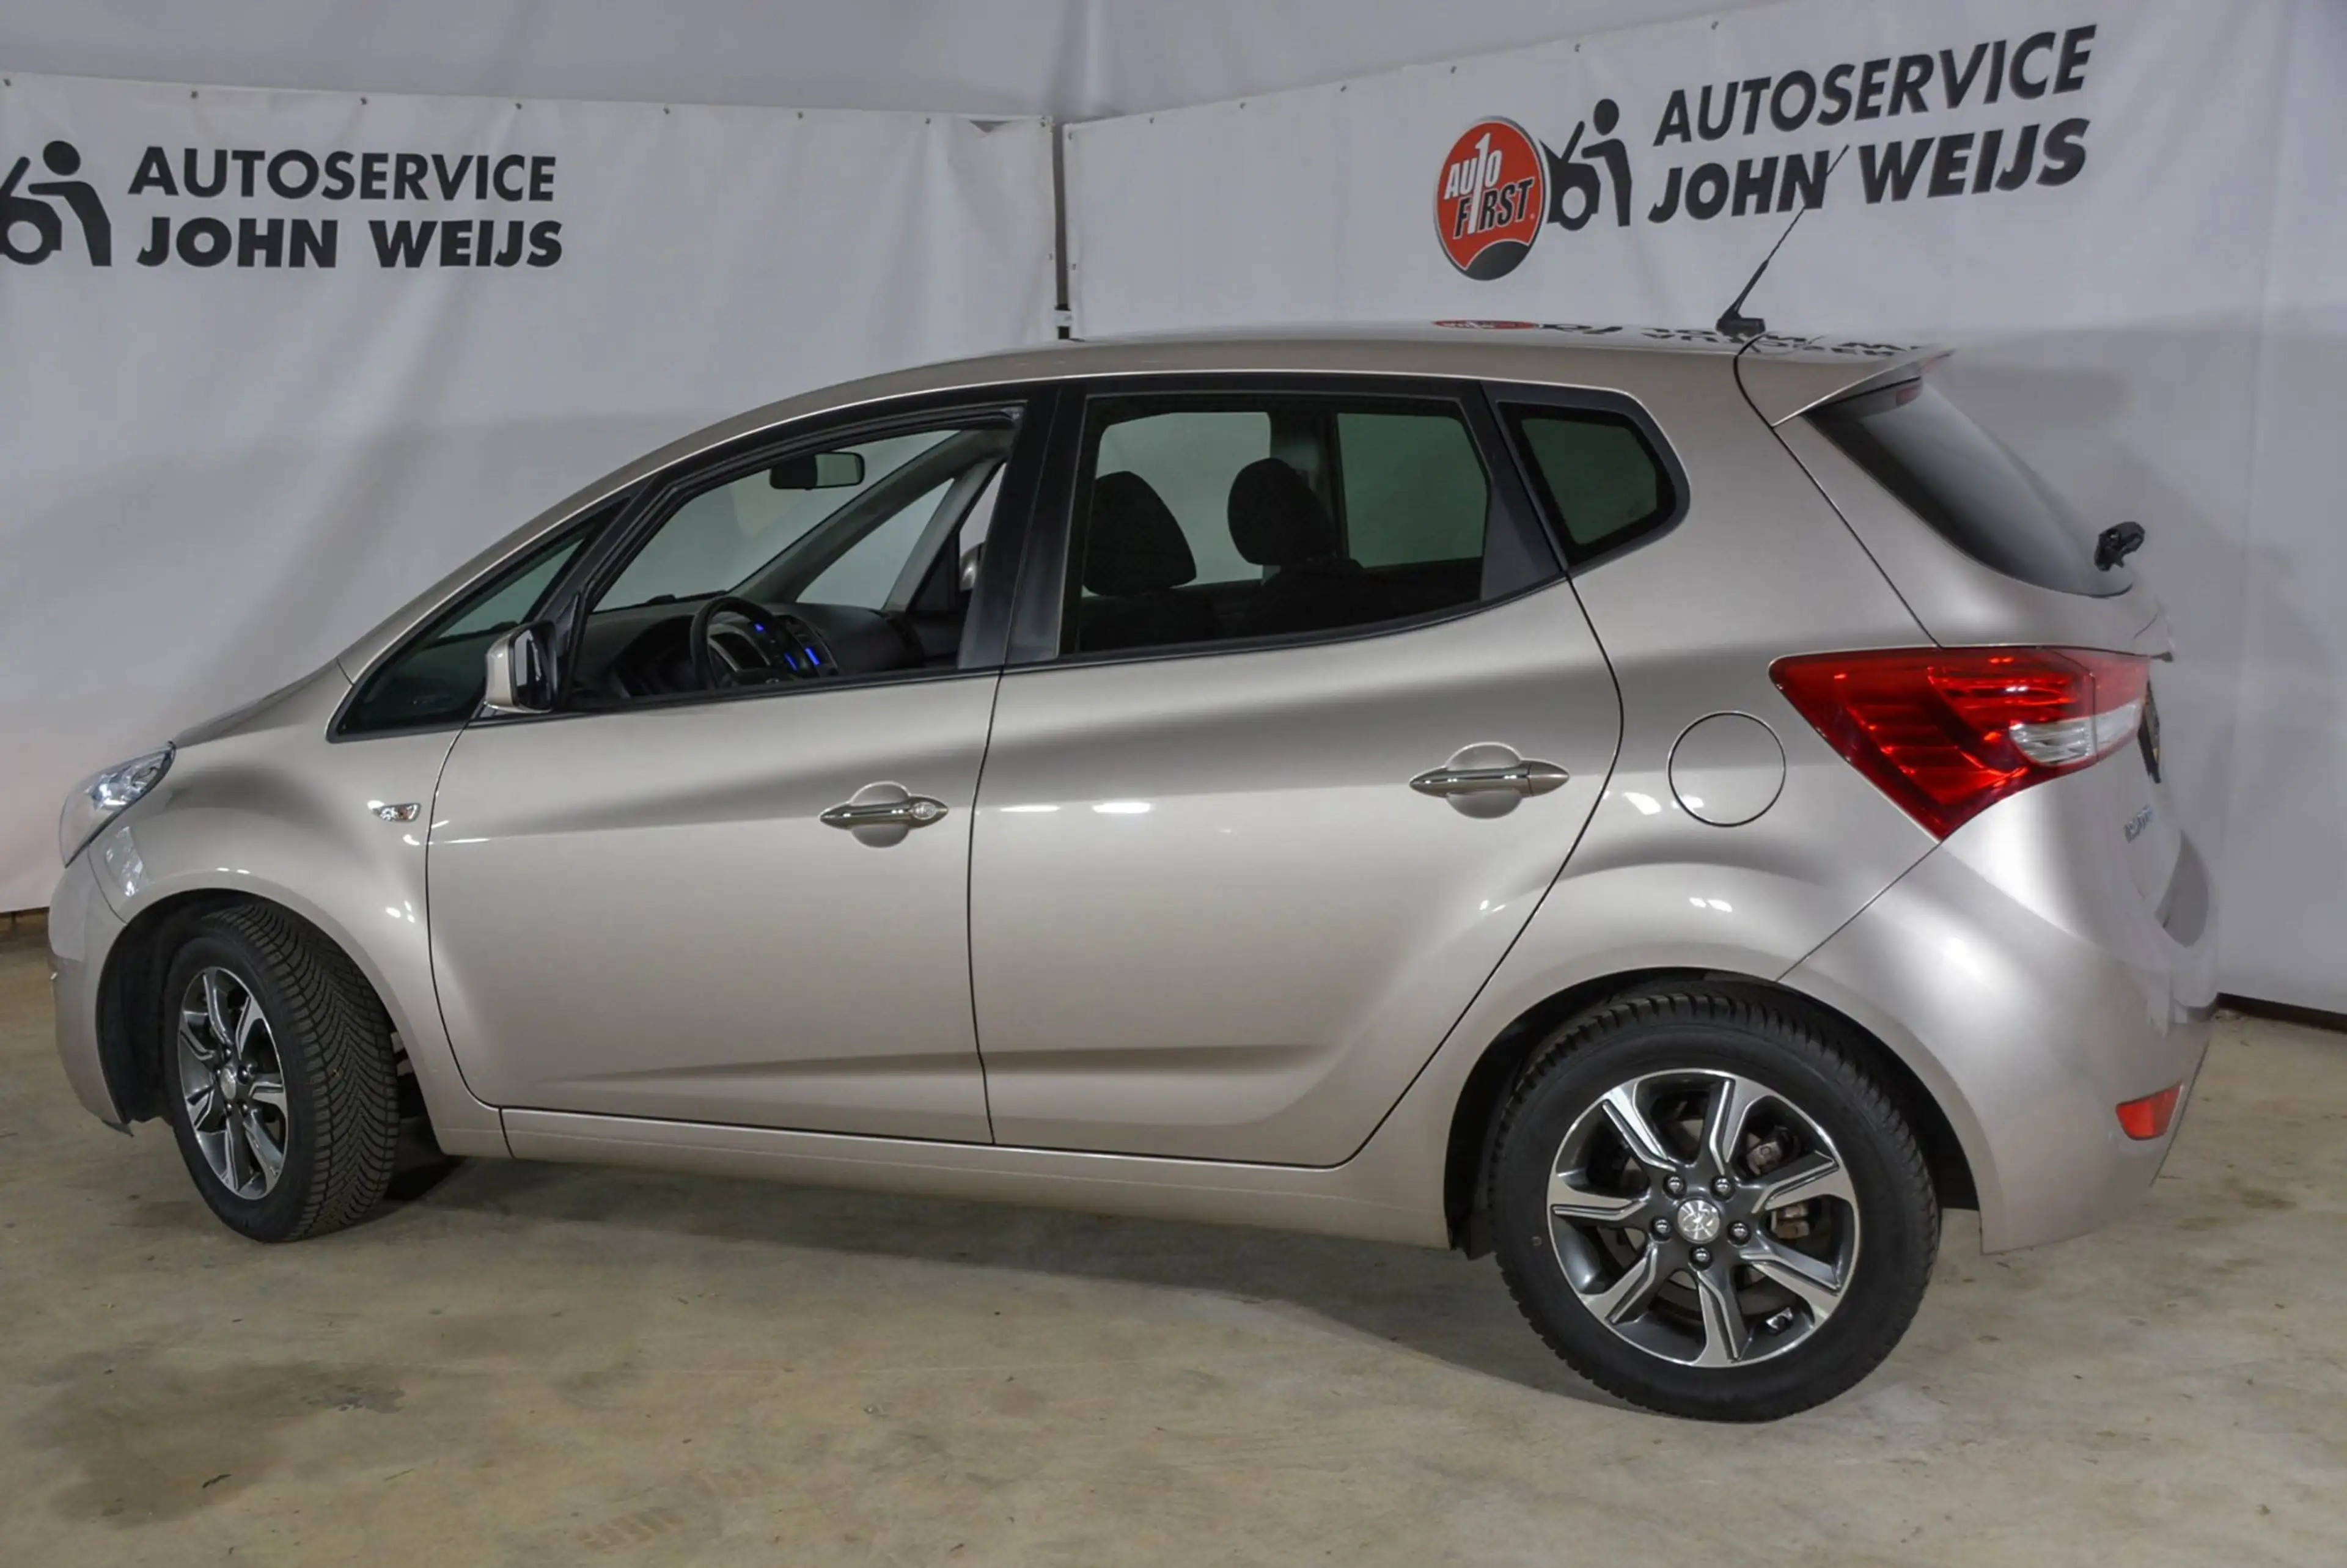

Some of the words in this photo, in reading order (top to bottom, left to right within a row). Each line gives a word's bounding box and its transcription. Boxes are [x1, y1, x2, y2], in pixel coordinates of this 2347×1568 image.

[1653, 24, 2097, 146] AUTOSERVICE
[128, 146, 556, 202] AUTOSERVICE
[1648, 150, 1830, 223] JOHN
[1859, 118, 2090, 204] WEIJS
[137, 216, 338, 268] JOHN
[368, 220, 562, 268] WEIJS
